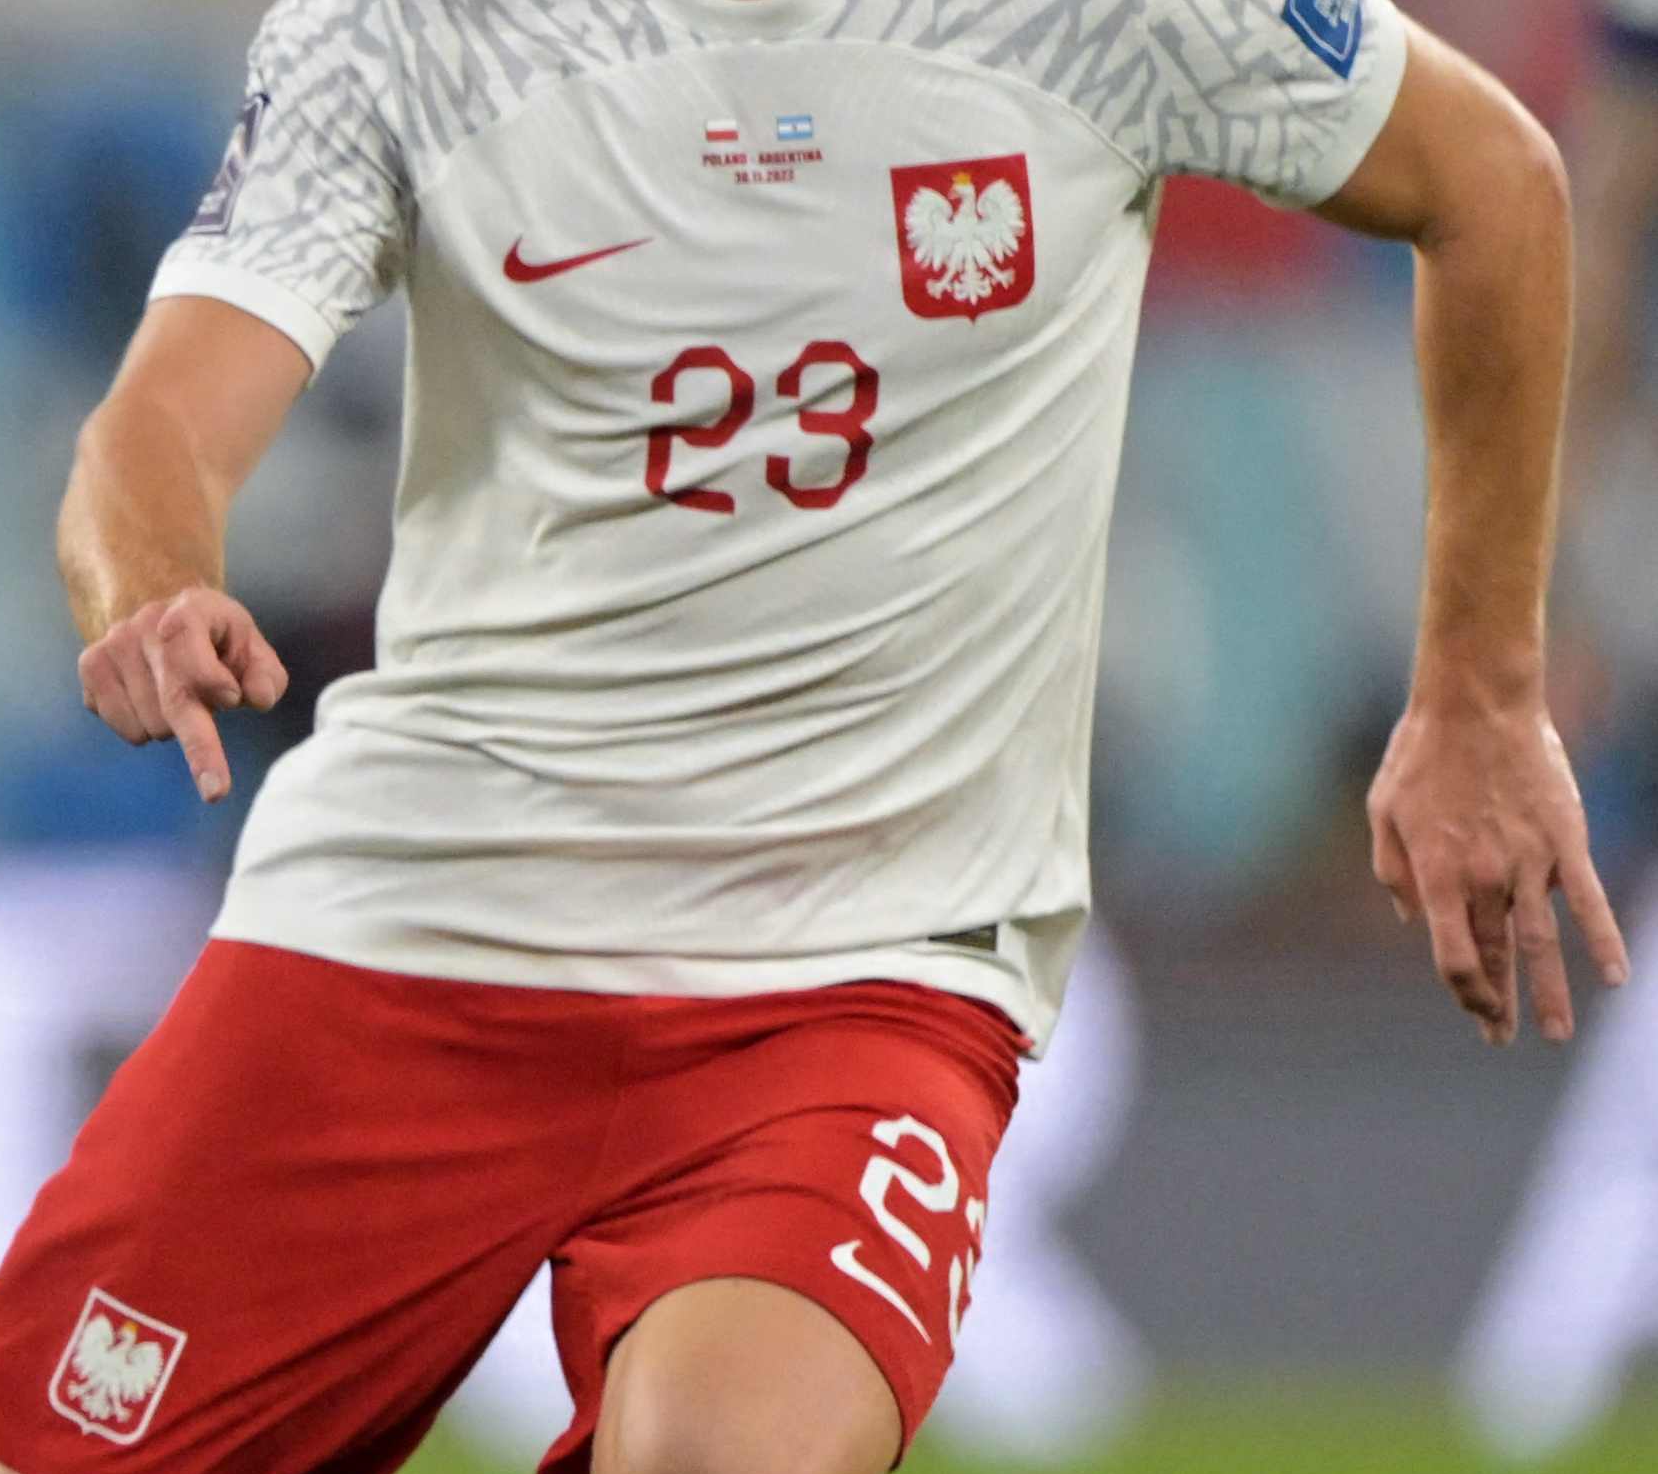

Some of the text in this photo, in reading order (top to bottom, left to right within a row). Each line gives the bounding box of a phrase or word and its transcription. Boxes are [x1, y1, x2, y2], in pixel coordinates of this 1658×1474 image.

[702, 149, 824, 167] POLAND ARGENTINA
[645, 340, 879, 515] 23
